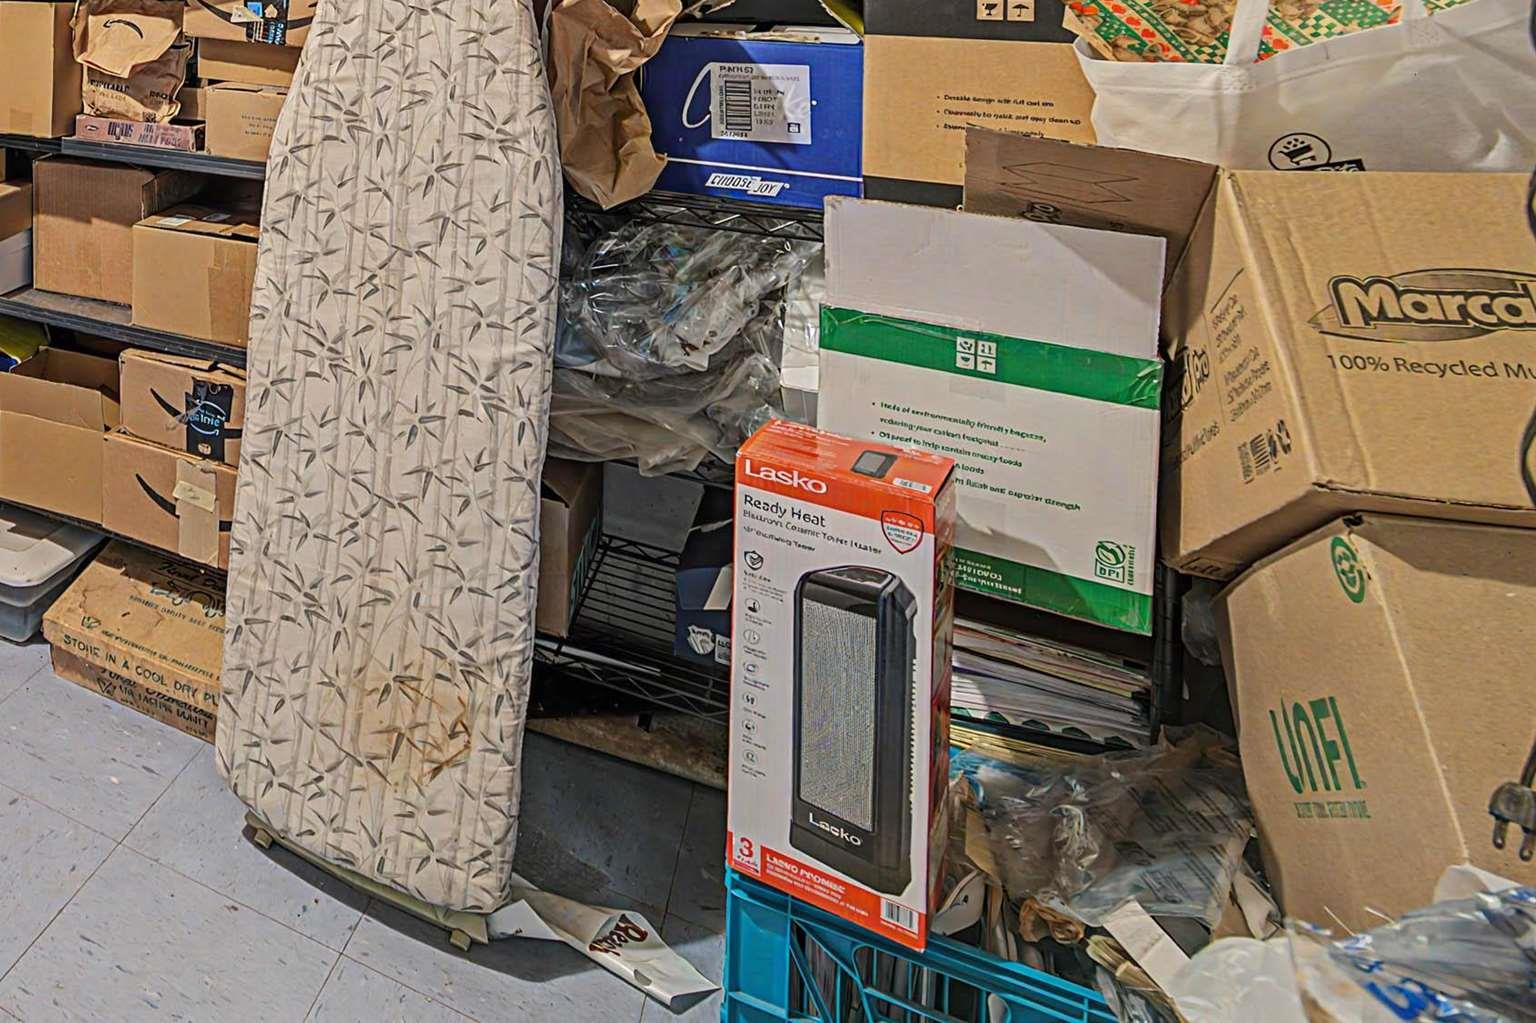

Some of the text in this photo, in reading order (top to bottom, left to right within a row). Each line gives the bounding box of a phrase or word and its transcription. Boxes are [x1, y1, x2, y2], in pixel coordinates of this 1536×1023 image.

[1327, 353, 1390, 373] 100%
[1393, 356, 1498, 379] Recycled
[744, 458, 828, 494] Lasko
[743, 494, 827, 527] Ready Heat
[134, 666, 168, 687] COOL
[739, 837, 754, 858] 3
